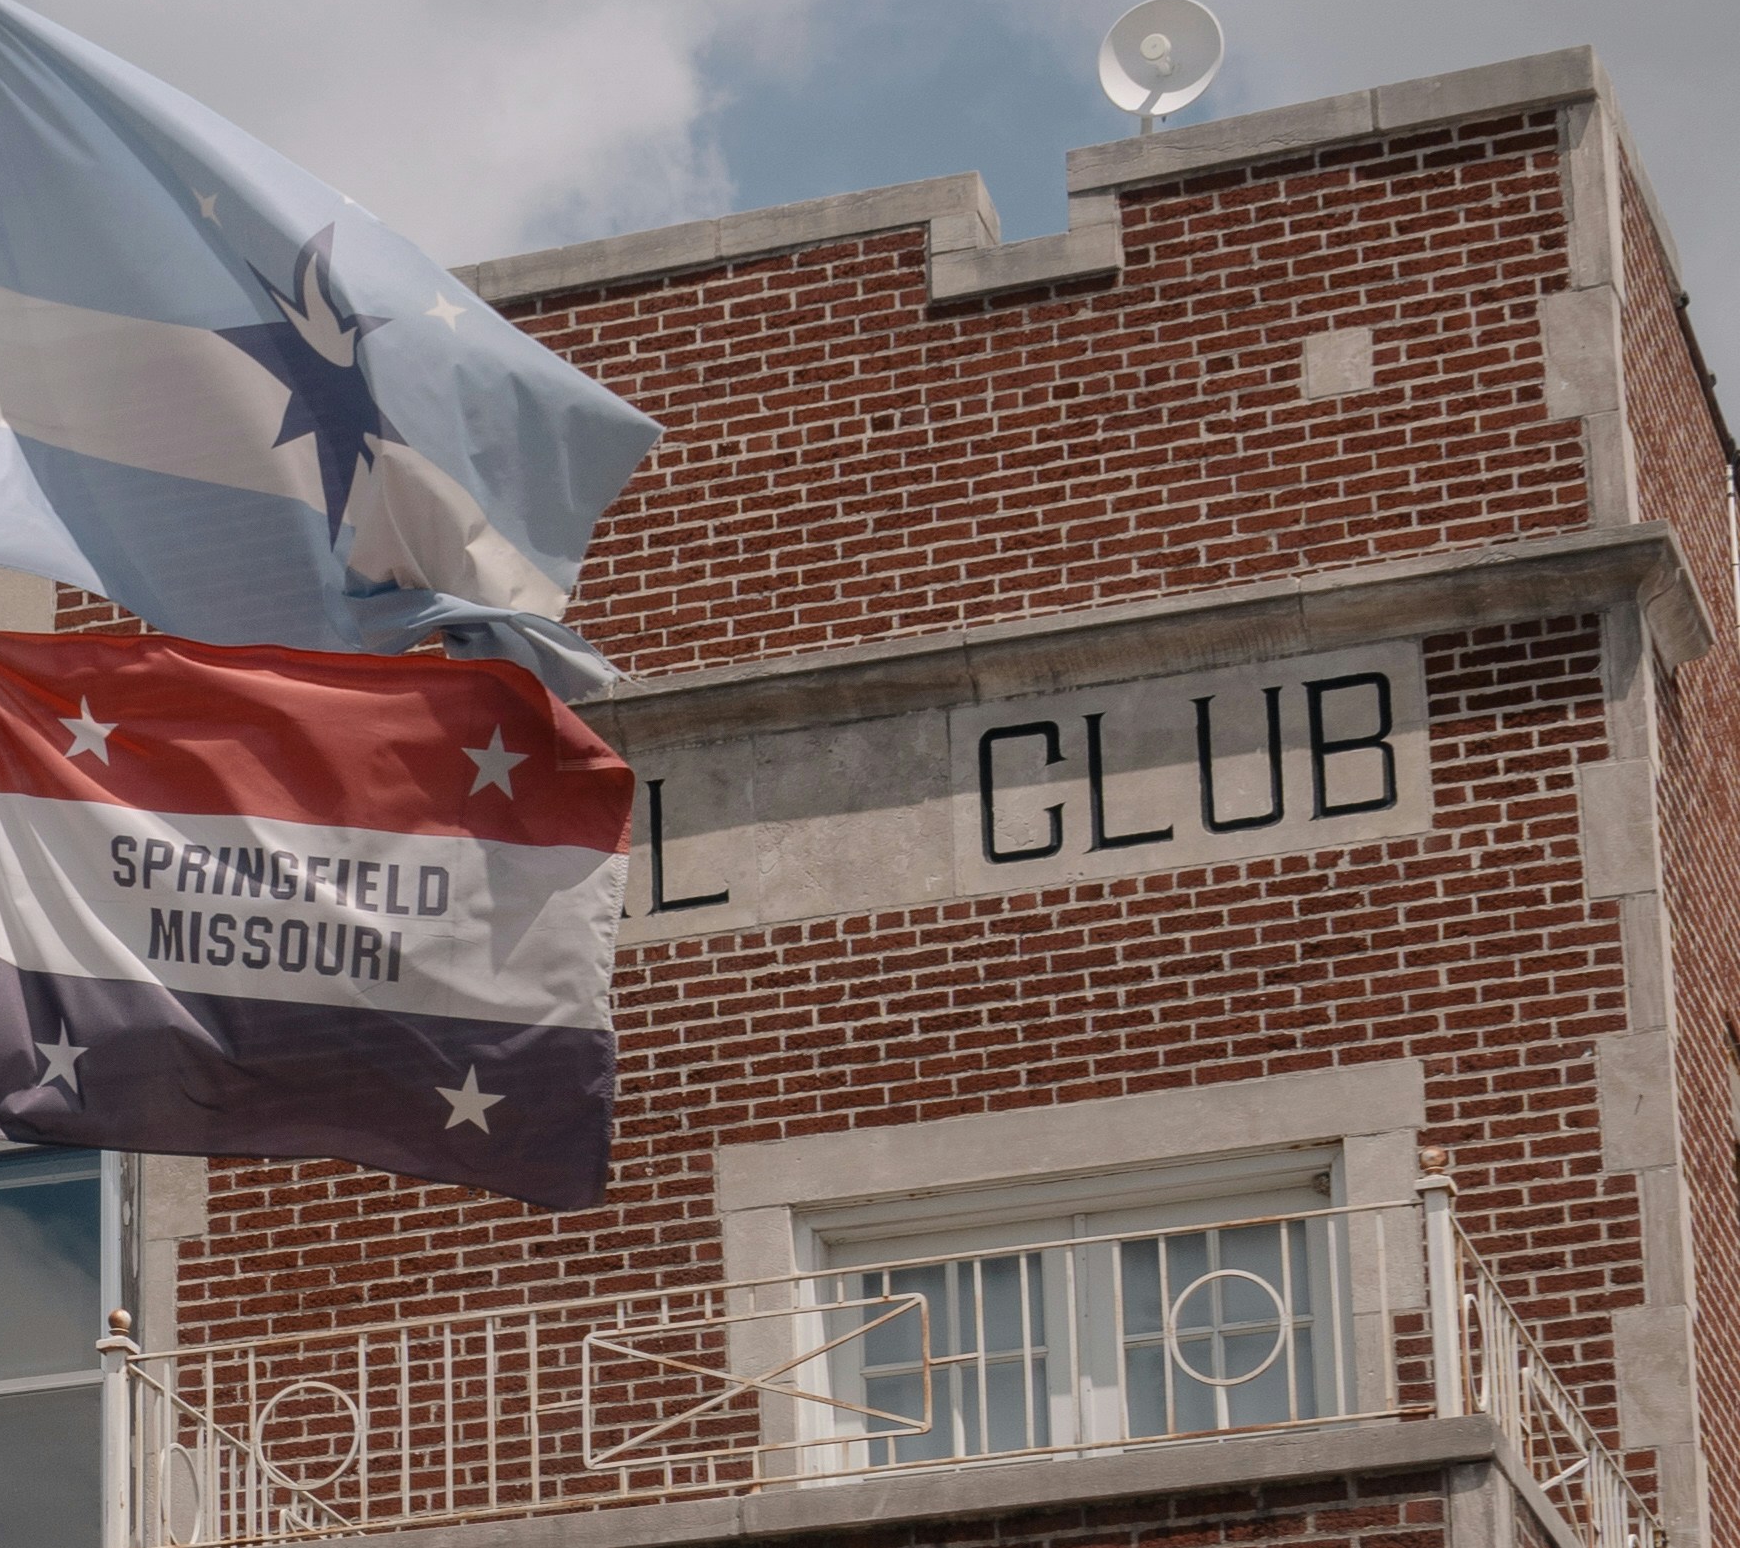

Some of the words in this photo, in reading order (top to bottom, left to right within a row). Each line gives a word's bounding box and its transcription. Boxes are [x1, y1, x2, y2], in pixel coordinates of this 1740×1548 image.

[978, 671, 1398, 865] CLUB
[111, 835, 449, 917] SPRINGFIELD
[148, 907, 402, 982] MISSOURI
